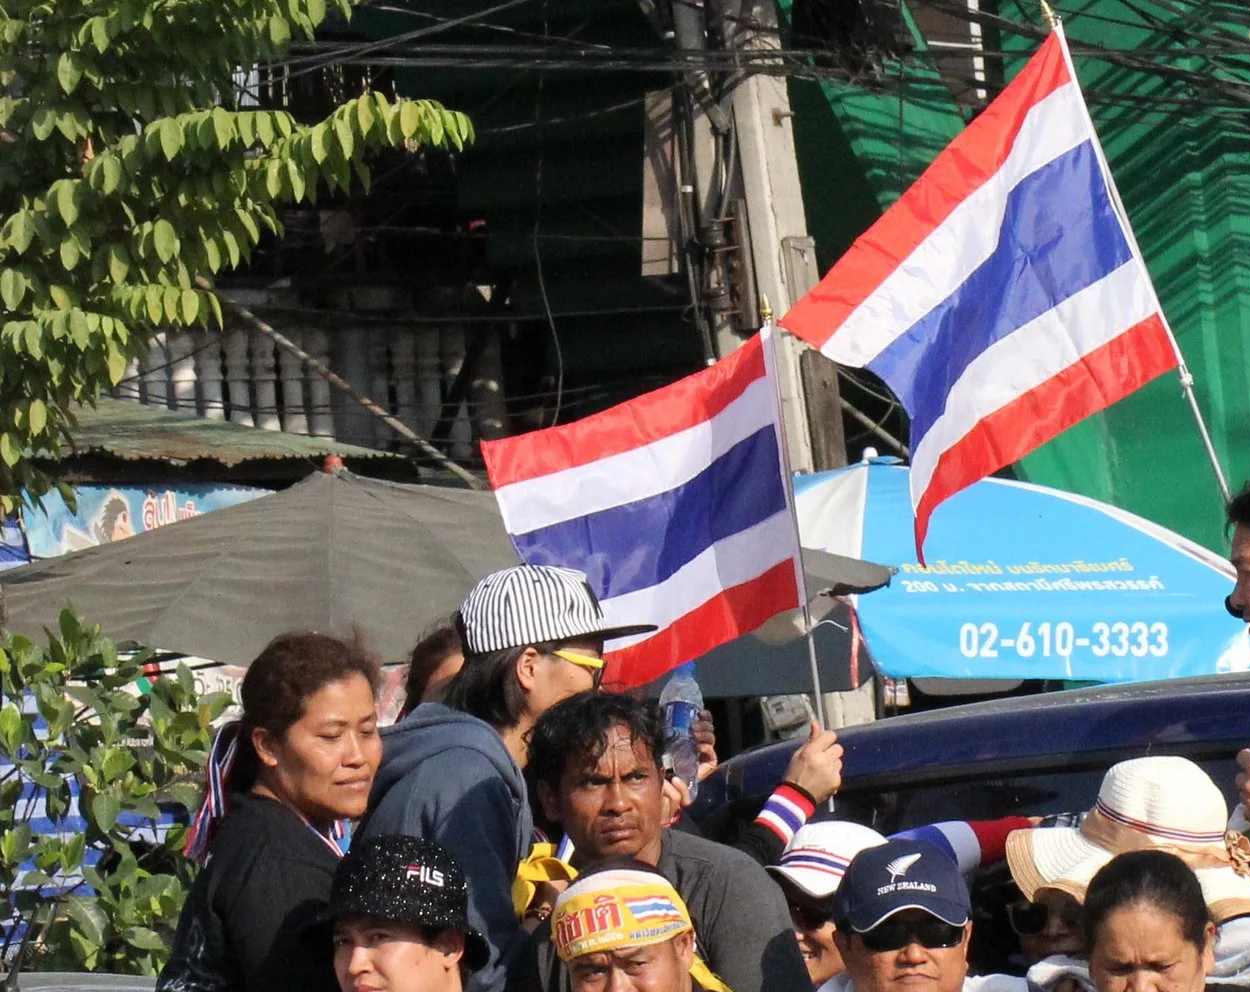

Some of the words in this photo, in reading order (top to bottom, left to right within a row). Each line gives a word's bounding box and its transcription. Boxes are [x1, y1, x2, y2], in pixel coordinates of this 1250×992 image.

[901, 580, 939, 592] 200
[960, 621, 1169, 658] 02-610-3333
[406, 864, 445, 887] FILA
[876, 885, 896, 896] NEW
[897, 881, 937, 893] ZEALAND
